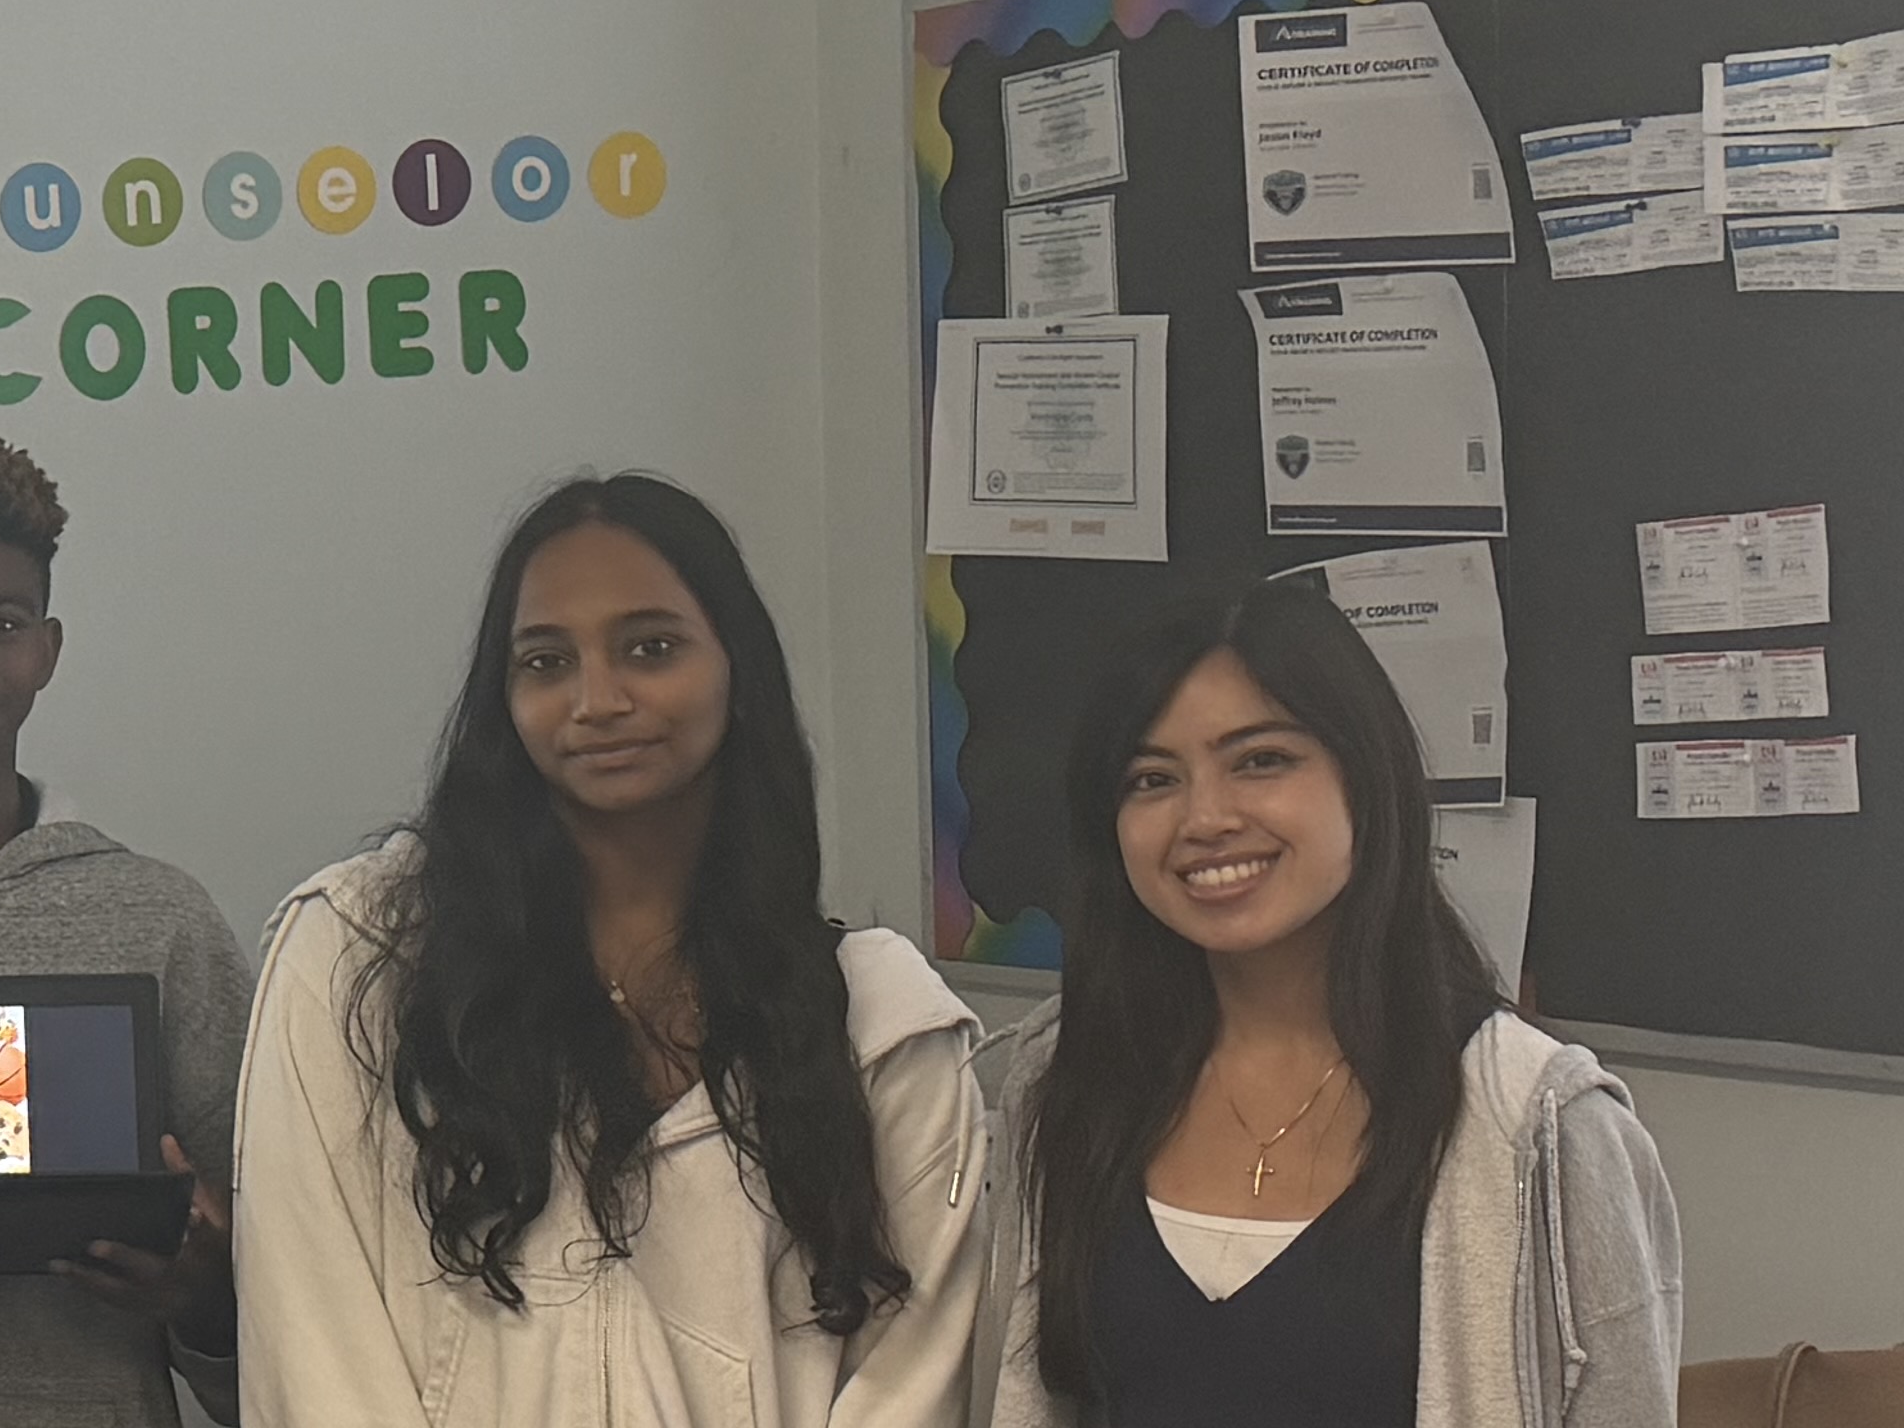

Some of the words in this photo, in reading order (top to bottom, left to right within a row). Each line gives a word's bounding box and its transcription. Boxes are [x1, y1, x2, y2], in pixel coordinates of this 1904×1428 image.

[1257, 63, 1351, 80] CERTIFICATE
[1354, 60, 1370, 74] OF
[1269, 330, 1347, 346] CERTIFICATE
[1350, 329, 1365, 343] OF
[1368, 327, 1438, 343] COMPLETION
[1366, 602, 1439, 618] COMPLETION
